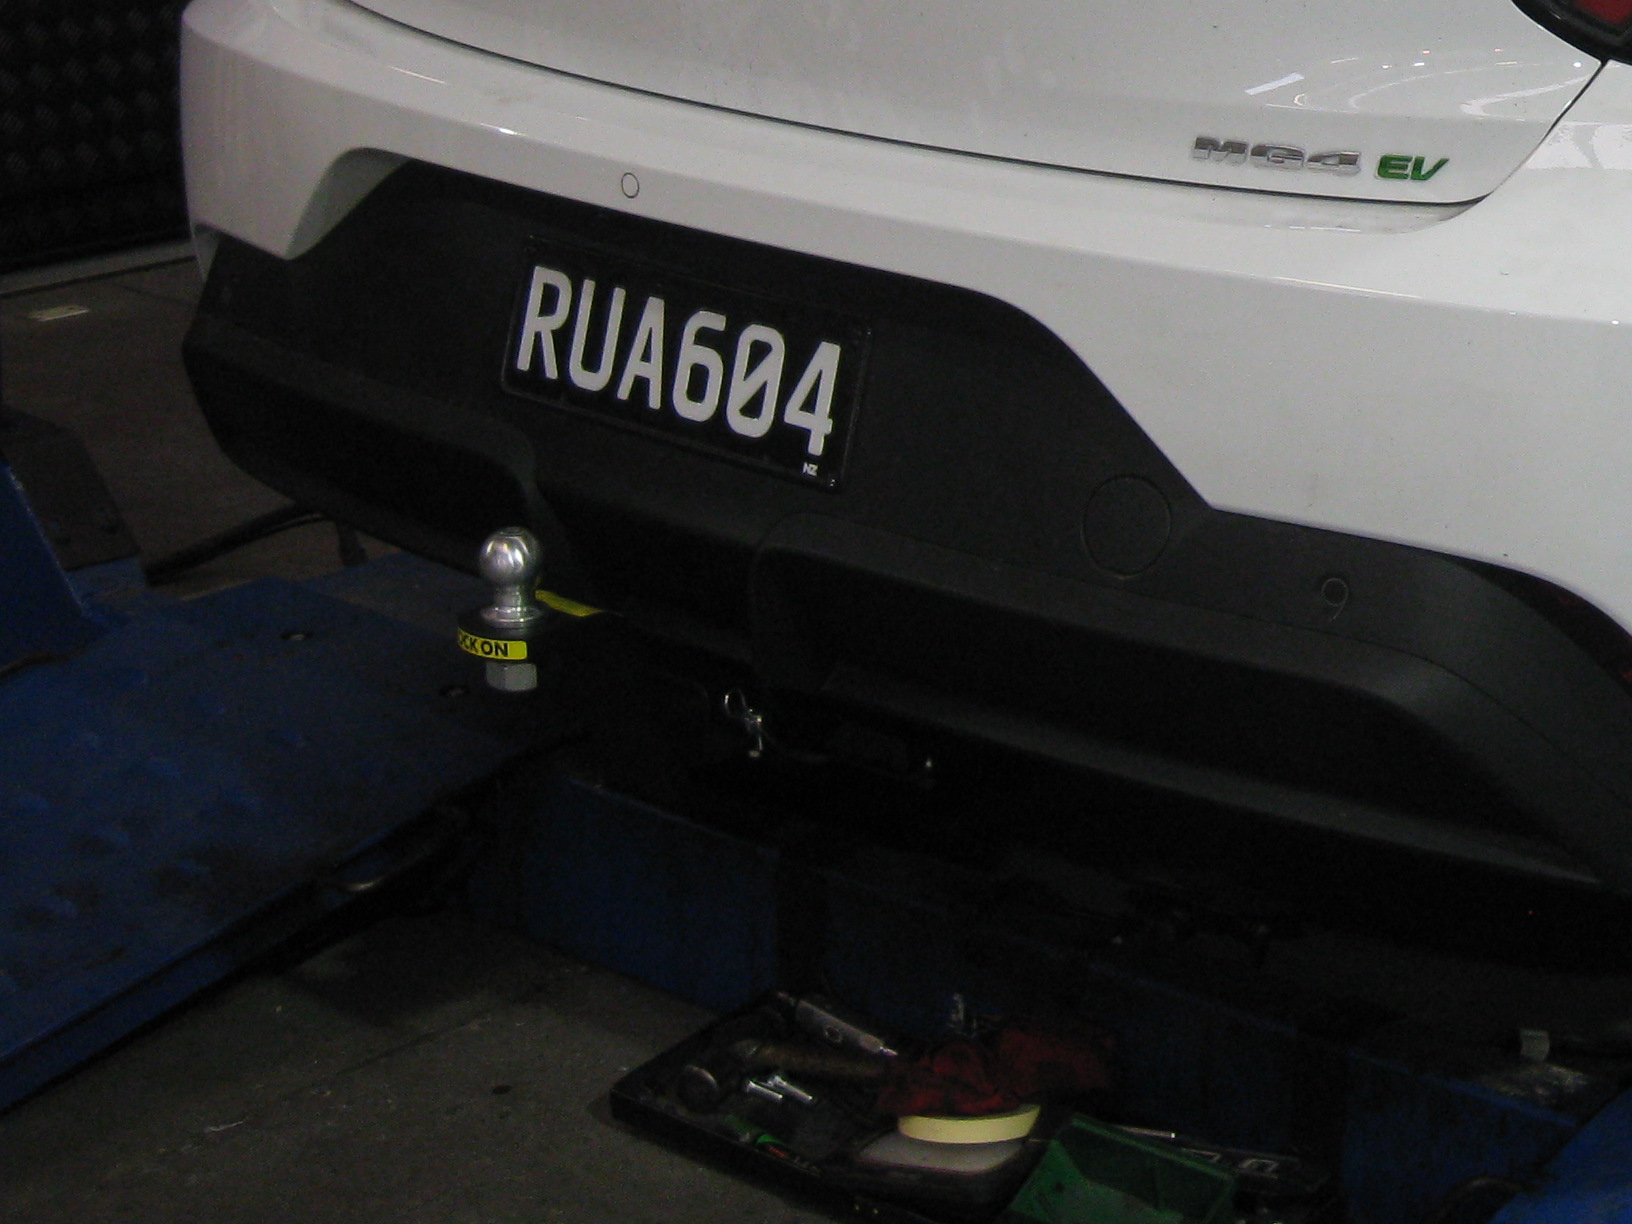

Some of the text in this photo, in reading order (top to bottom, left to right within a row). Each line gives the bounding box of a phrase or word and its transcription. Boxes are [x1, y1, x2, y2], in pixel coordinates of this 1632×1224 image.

[1375, 153, 1450, 181] EV
[516, 265, 842, 457] RUA604
[803, 462, 819, 476] NZ
[481, 640, 508, 657] ON
